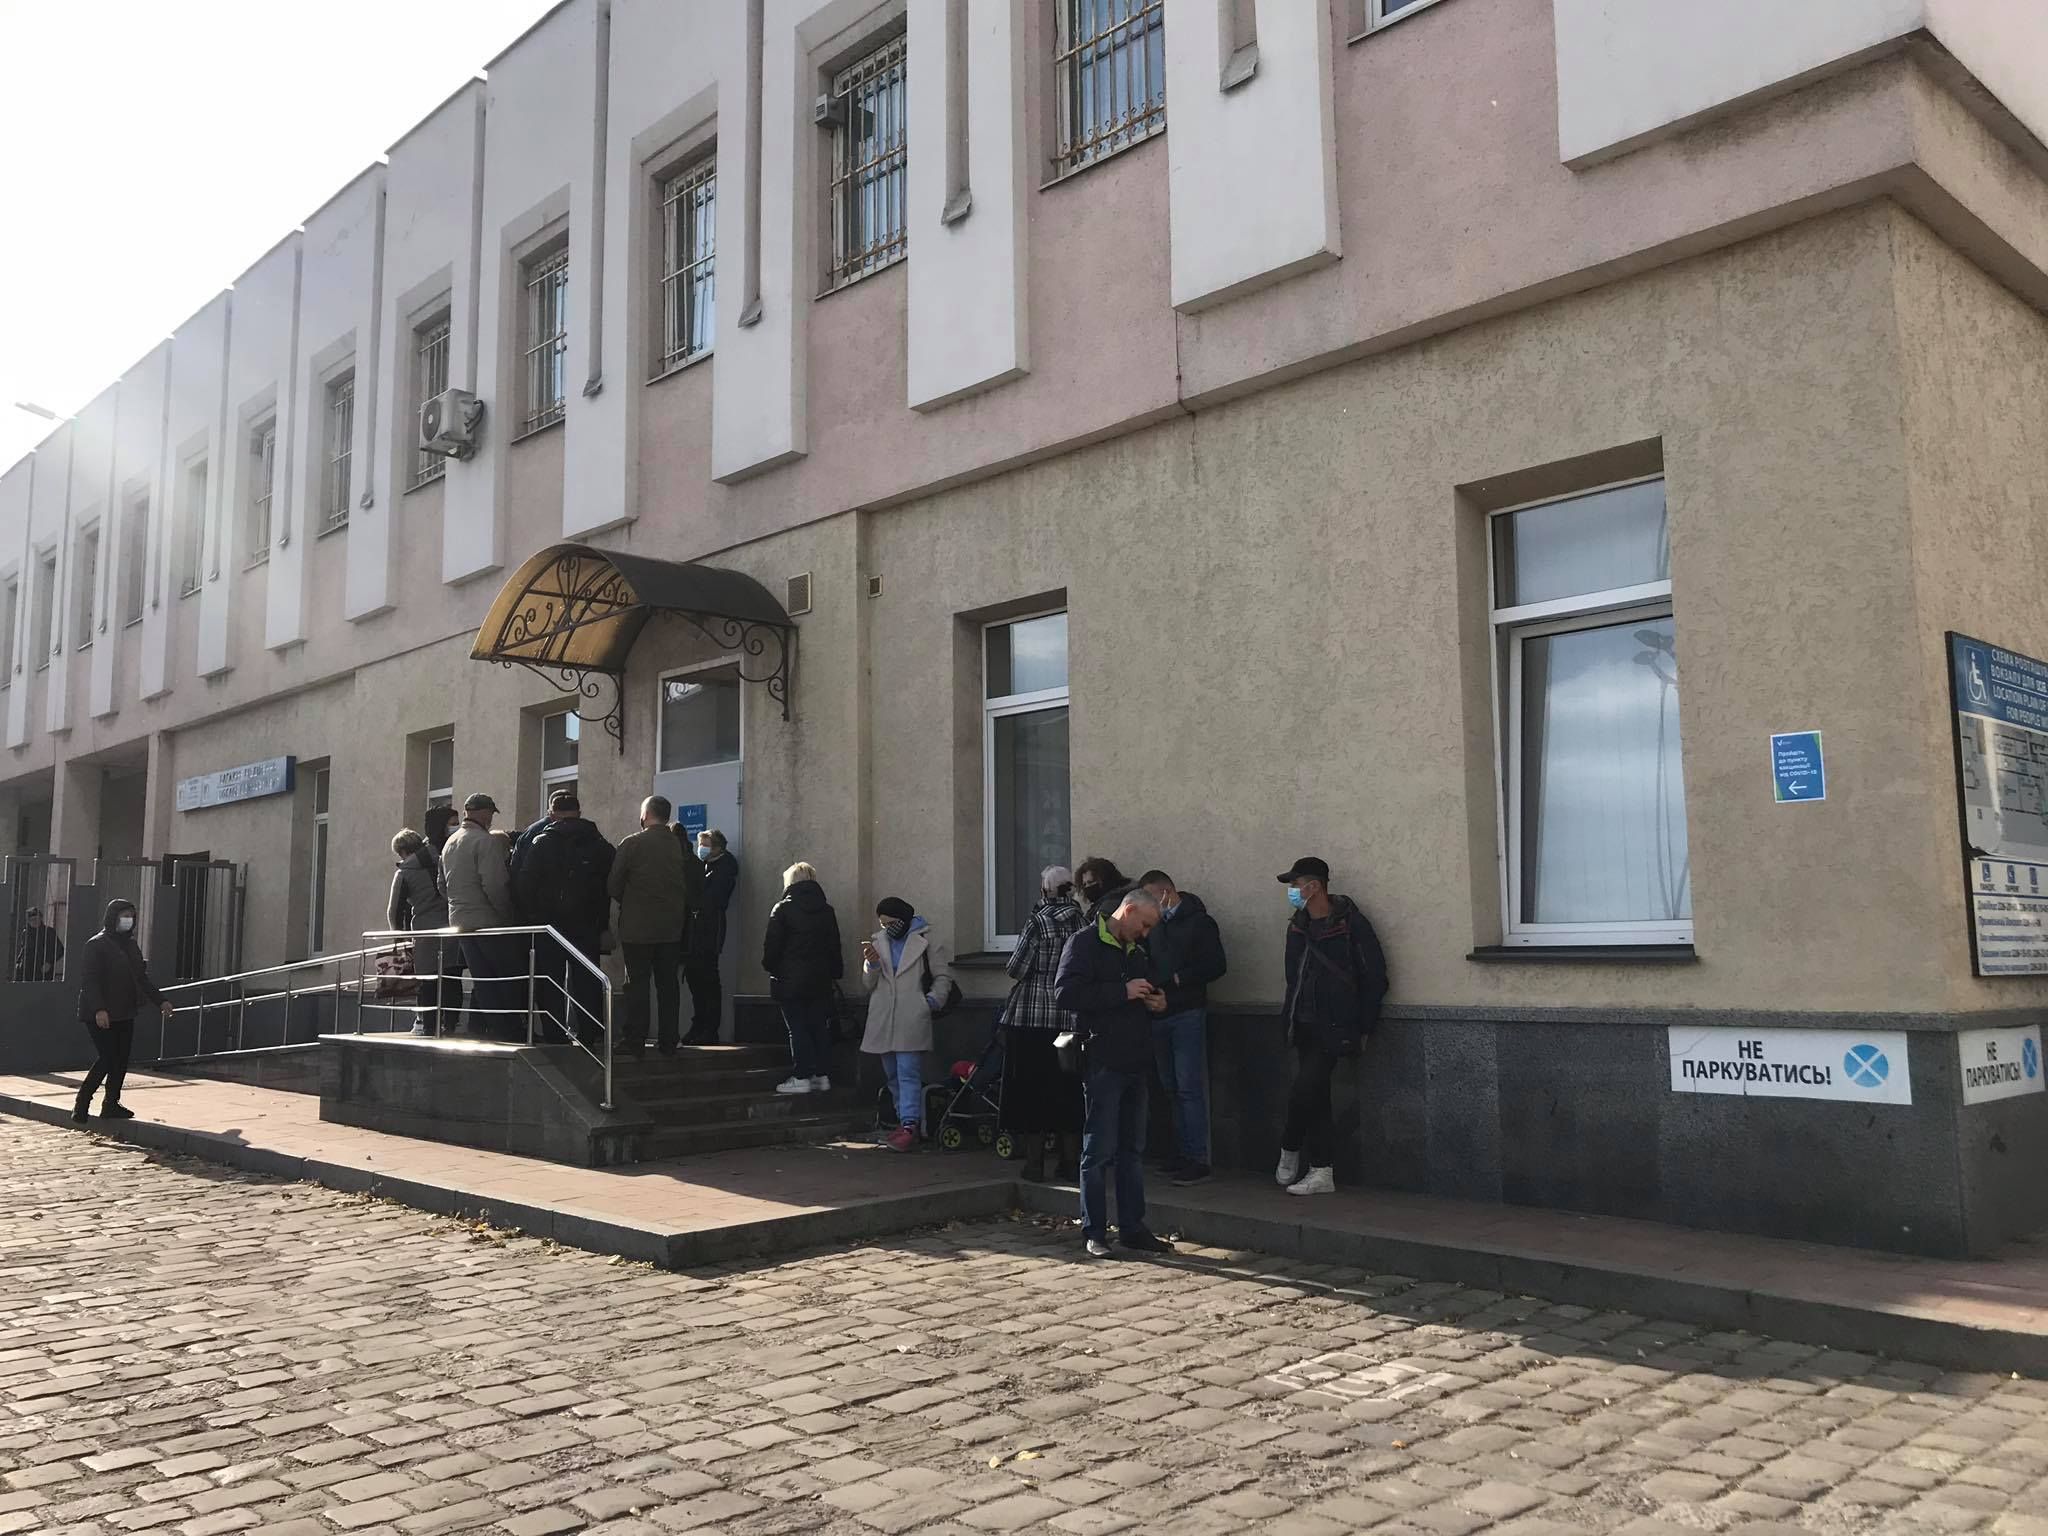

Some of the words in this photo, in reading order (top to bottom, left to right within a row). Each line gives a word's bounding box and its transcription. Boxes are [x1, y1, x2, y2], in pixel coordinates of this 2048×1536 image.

[1992, 685, 2023, 704] LOCATION
[1738, 1040, 1764, 1060] НЕ
[1986, 1041, 1997, 1062] НЕ
[1682, 1059, 1832, 1086] ПАРКУВАТИСЬ!
